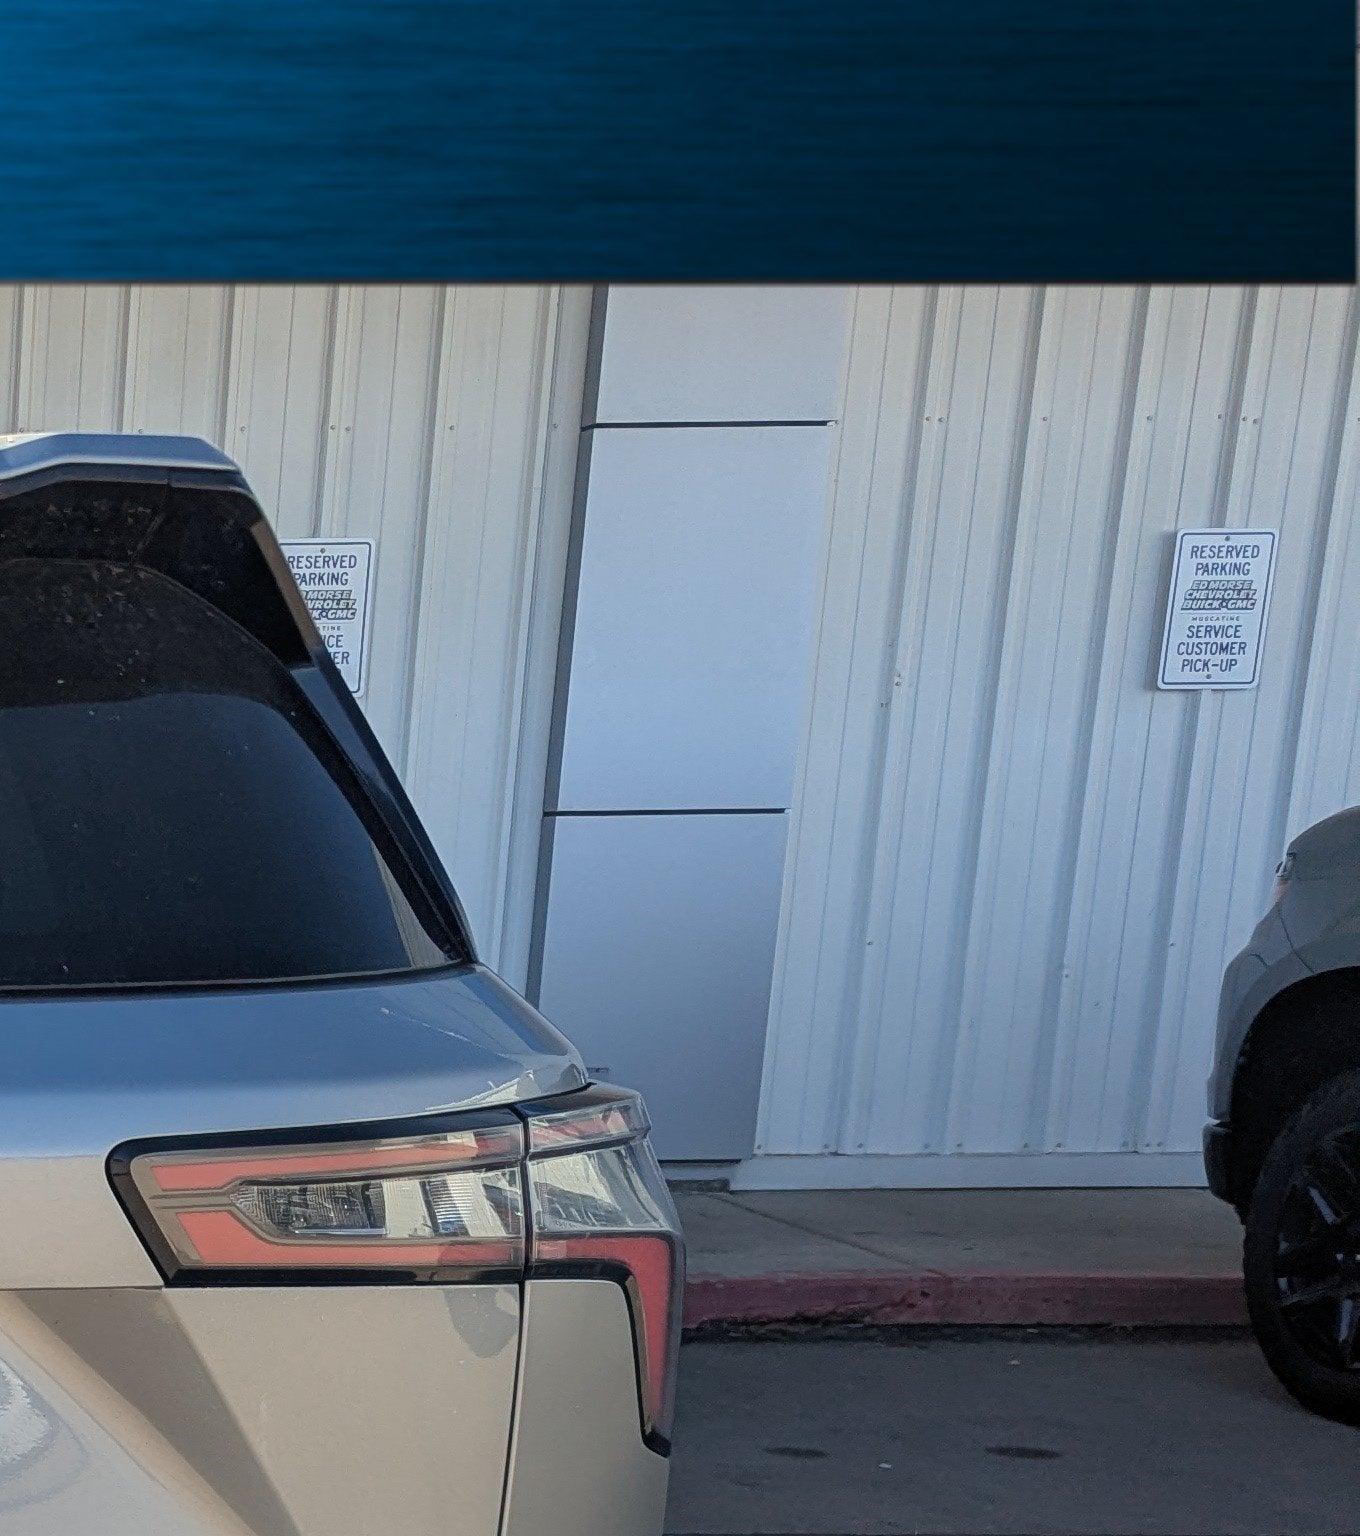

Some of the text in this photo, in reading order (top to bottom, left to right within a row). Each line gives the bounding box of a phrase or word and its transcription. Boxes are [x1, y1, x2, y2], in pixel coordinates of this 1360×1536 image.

[1190, 545, 1260, 559] RESERVED
[287, 554, 358, 569] RESERVED
[1195, 562, 1251, 576] PARKING
[294, 572, 349, 586] PARKING
[1191, 580, 1253, 590] ED MORSE
[306, 590, 352, 600] MORSE
[1185, 589, 1257, 599] CHEVROLET
[307, 599, 356, 609] VROLET
[1181, 599, 1256, 610] BUICK GMC
[327, 609, 357, 620] GMC
[1186, 625, 1242, 639] SERVICE
[1176, 641, 1247, 656] CUSTOMER
[1180, 658, 1238, 673] PICK-UP
